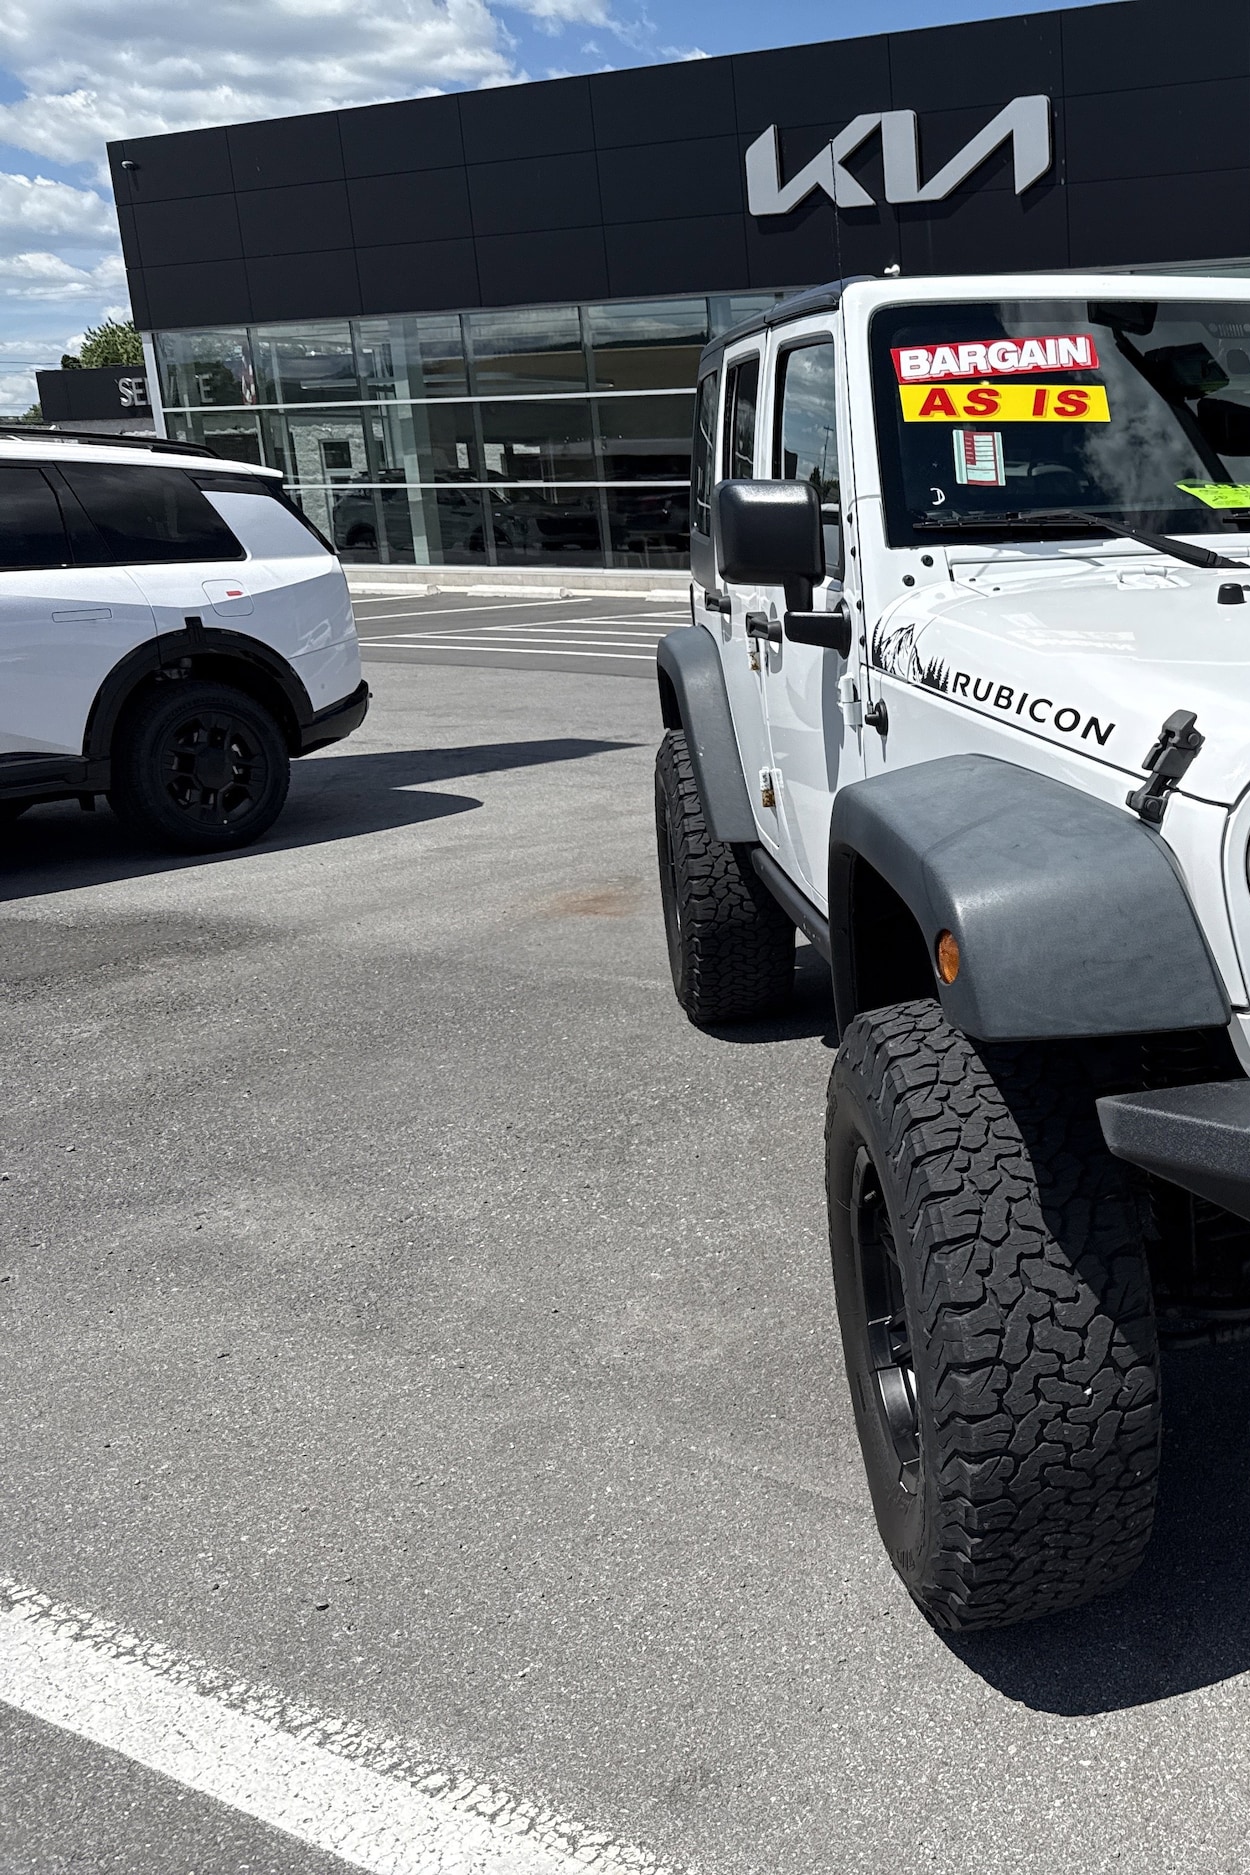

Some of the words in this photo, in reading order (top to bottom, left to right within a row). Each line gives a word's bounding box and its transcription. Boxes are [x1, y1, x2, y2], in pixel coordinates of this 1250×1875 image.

[745, 94, 1050, 217] KIA
[899, 336, 1093, 380] BARGAIN
[918, 387, 1001, 418] AS
[1031, 388, 1091, 418] IS
[952, 671, 1116, 746] RUBICON
